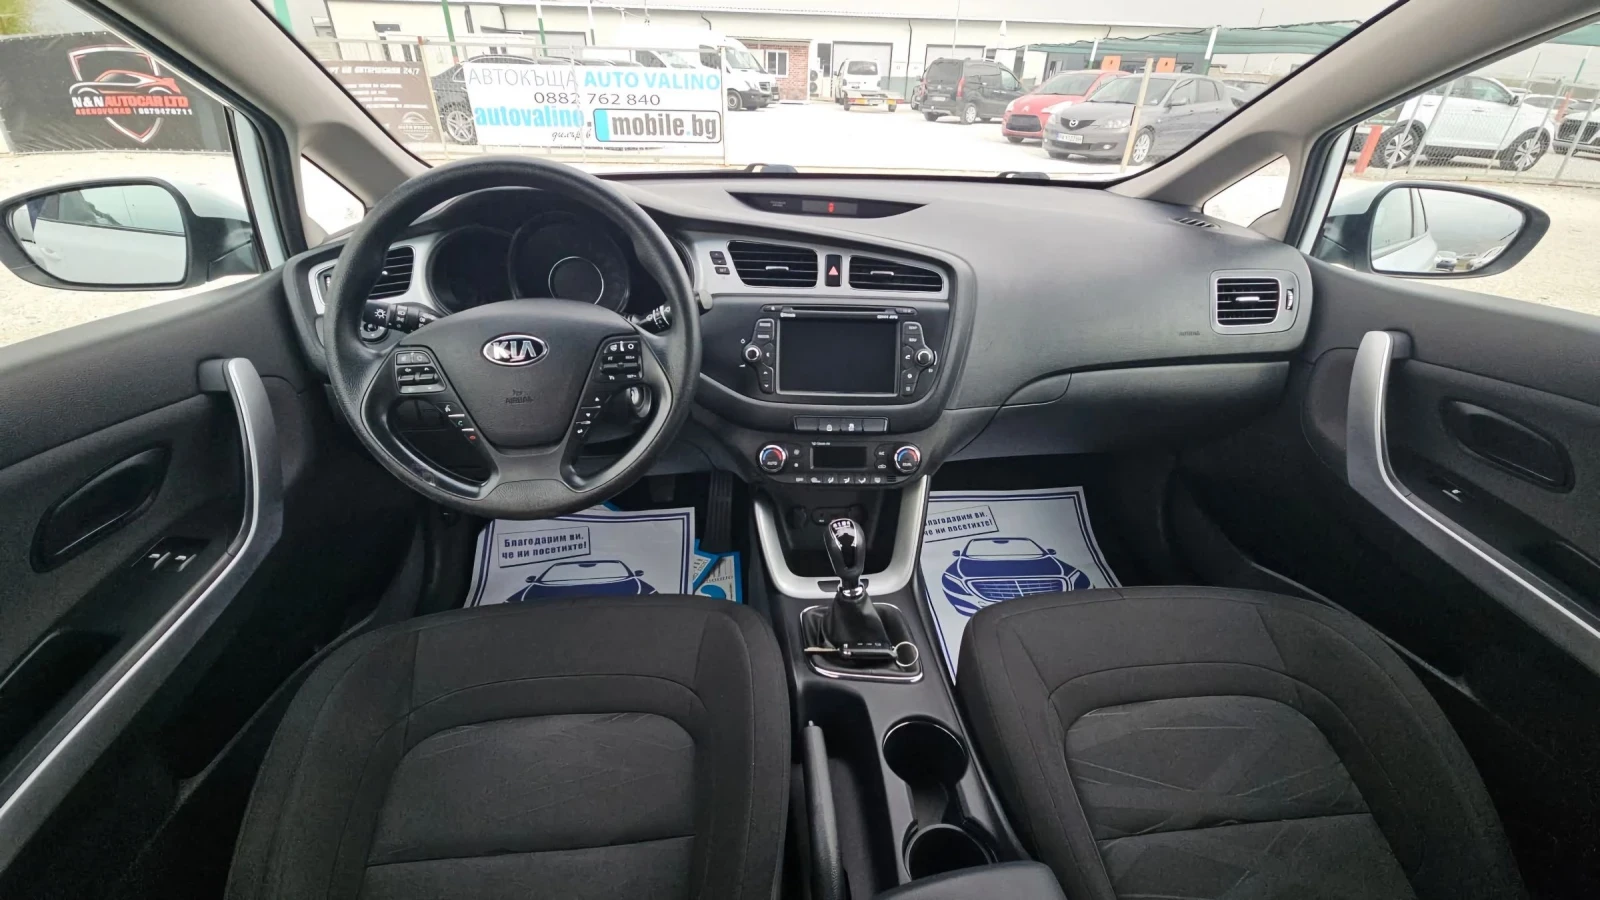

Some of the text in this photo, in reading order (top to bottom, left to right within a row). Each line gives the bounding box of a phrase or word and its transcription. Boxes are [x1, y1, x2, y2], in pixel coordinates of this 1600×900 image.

[469, 68, 577, 90] АВТОКЪЩА
[584, 71, 720, 90] AUTO VALINO
[163, 96, 189, 108] LTD
[534, 92, 661, 106] 0882 762 840
[612, 113, 717, 140] mobile.bg
[492, 340, 537, 359] KIA
[947, 518, 993, 532] посетихте!
[502, 541, 587, 559] че ни посетихте!
[504, 535, 567, 548] Благодарим
